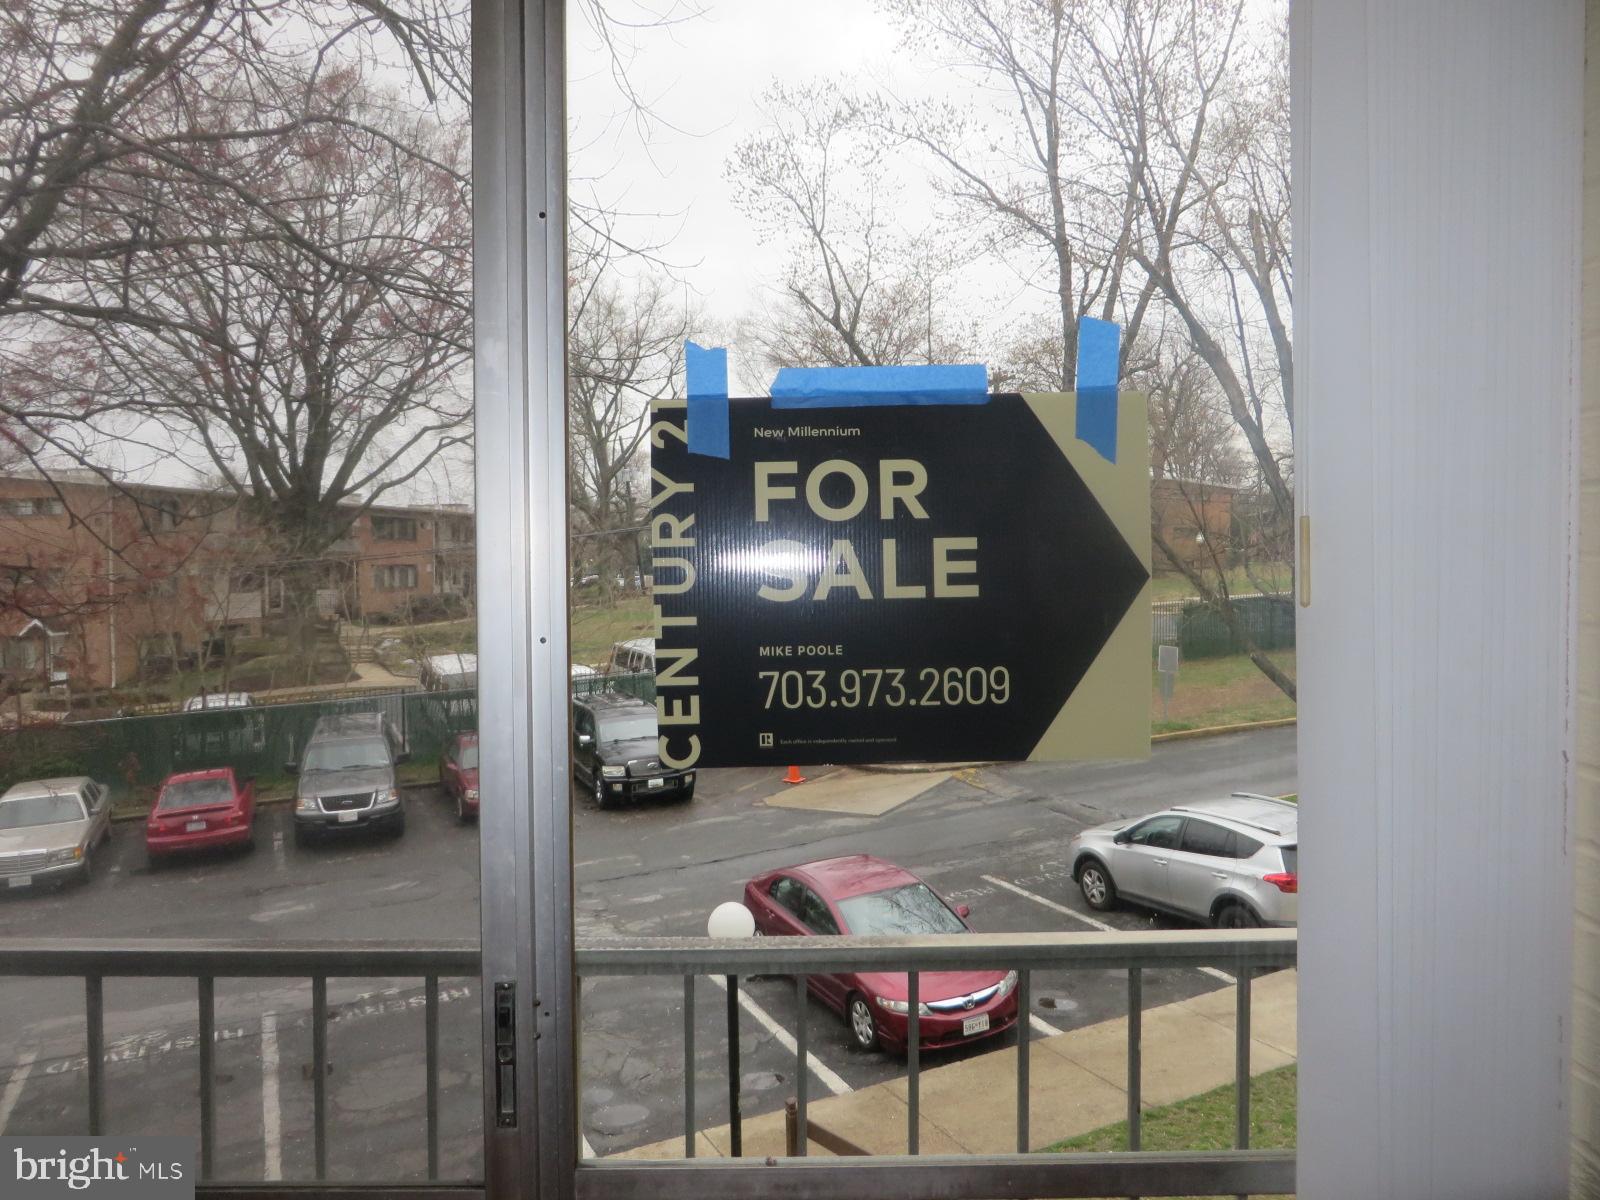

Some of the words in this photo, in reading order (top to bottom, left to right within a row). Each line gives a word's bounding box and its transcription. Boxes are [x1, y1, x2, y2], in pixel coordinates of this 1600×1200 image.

[754, 426, 784, 438] New
[787, 425, 861, 437] Millennium
[754, 459, 930, 522] FOR
[756, 537, 980, 602] SALE
[650, 467, 702, 770] CENTURY
[759, 645, 793, 657] MIKE
[797, 644, 843, 656] POOLE
[758, 665, 1010, 709] 703.973.2609
